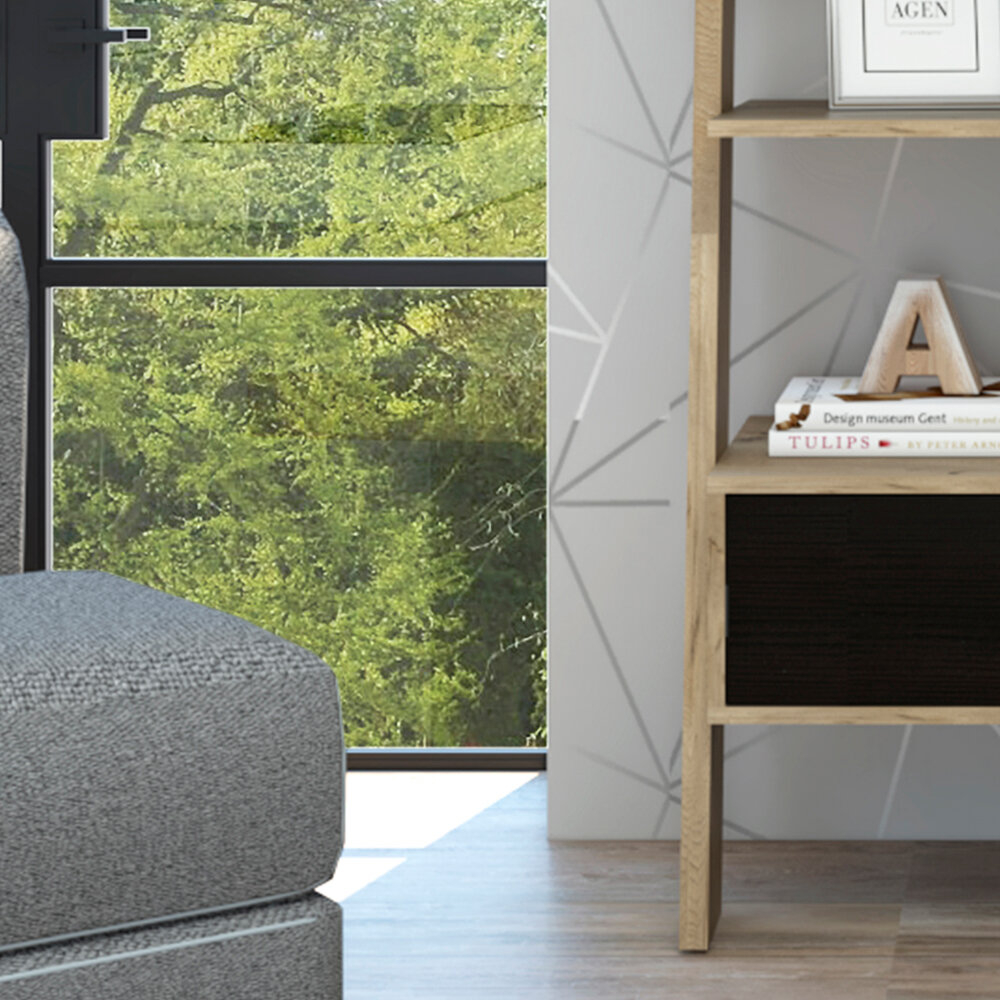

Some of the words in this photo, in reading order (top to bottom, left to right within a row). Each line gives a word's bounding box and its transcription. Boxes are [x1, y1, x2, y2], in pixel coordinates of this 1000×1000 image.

[892, 1, 948, 18] AGEN
[824, 413, 863, 426] Design
[866, 414, 915, 424] museum
[918, 413, 946, 424] Gent
[982, 416, 997, 424] and
[788, 436, 870, 449] TULIPS
[927, 441, 967, 449] PETER
